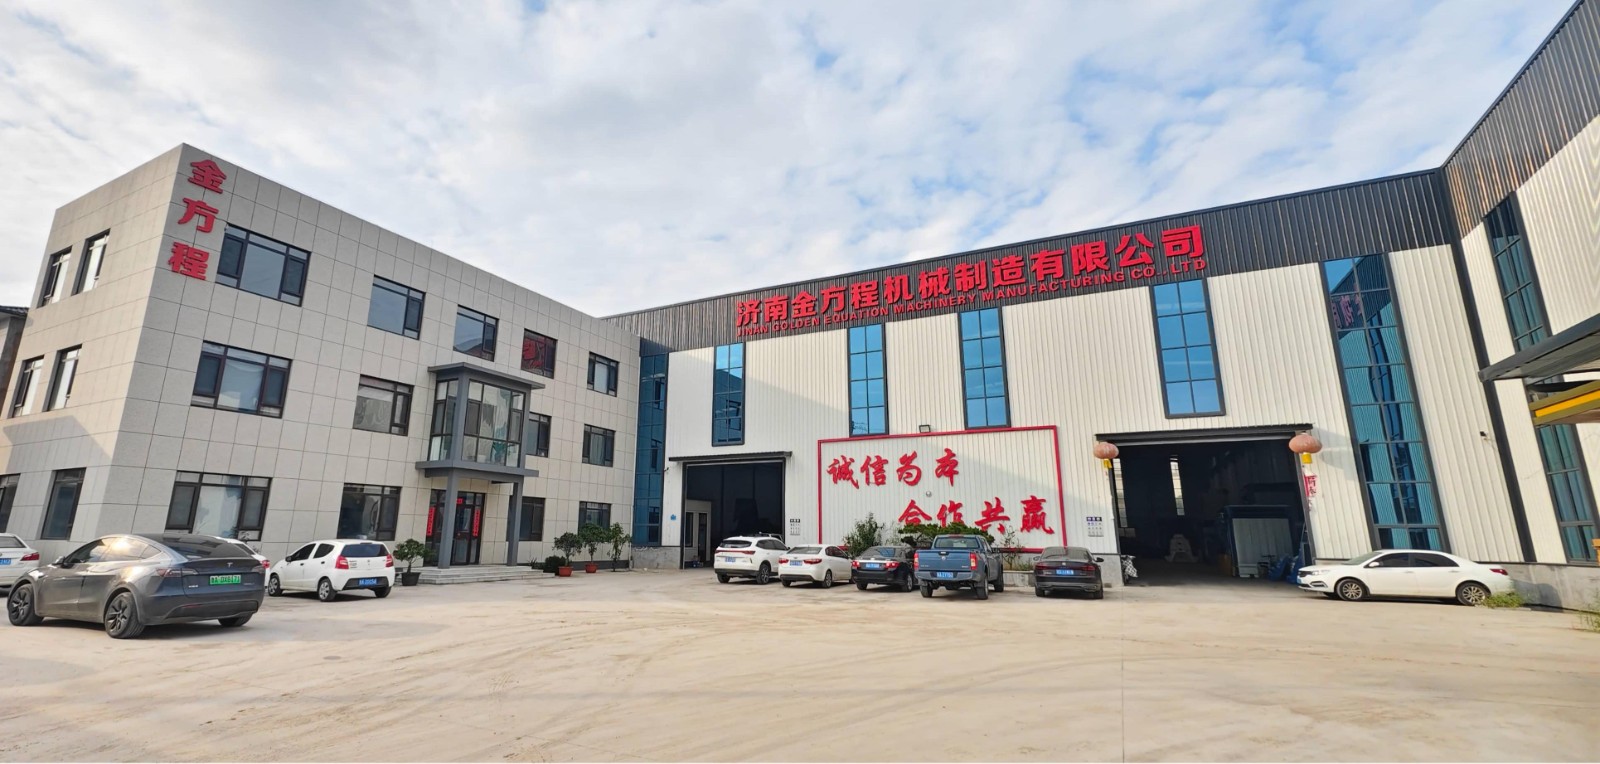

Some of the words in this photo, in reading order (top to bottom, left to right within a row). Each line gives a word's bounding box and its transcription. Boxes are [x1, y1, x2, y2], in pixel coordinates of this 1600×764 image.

[168, 159, 227, 281] 金方程
[736, 224, 1205, 327] 济南金方程机械制造有限公司
[737, 326, 769, 336] JINAN
[772, 317, 820, 331] GOLDEN
[824, 307, 889, 324] EQUATION
[894, 294, 976, 313] MACHINERY
[982, 271, 1125, 301] MANUFACTURING
[827, 448, 960, 489] 诚信为本
[898, 495, 1055, 534] 合作共赢
